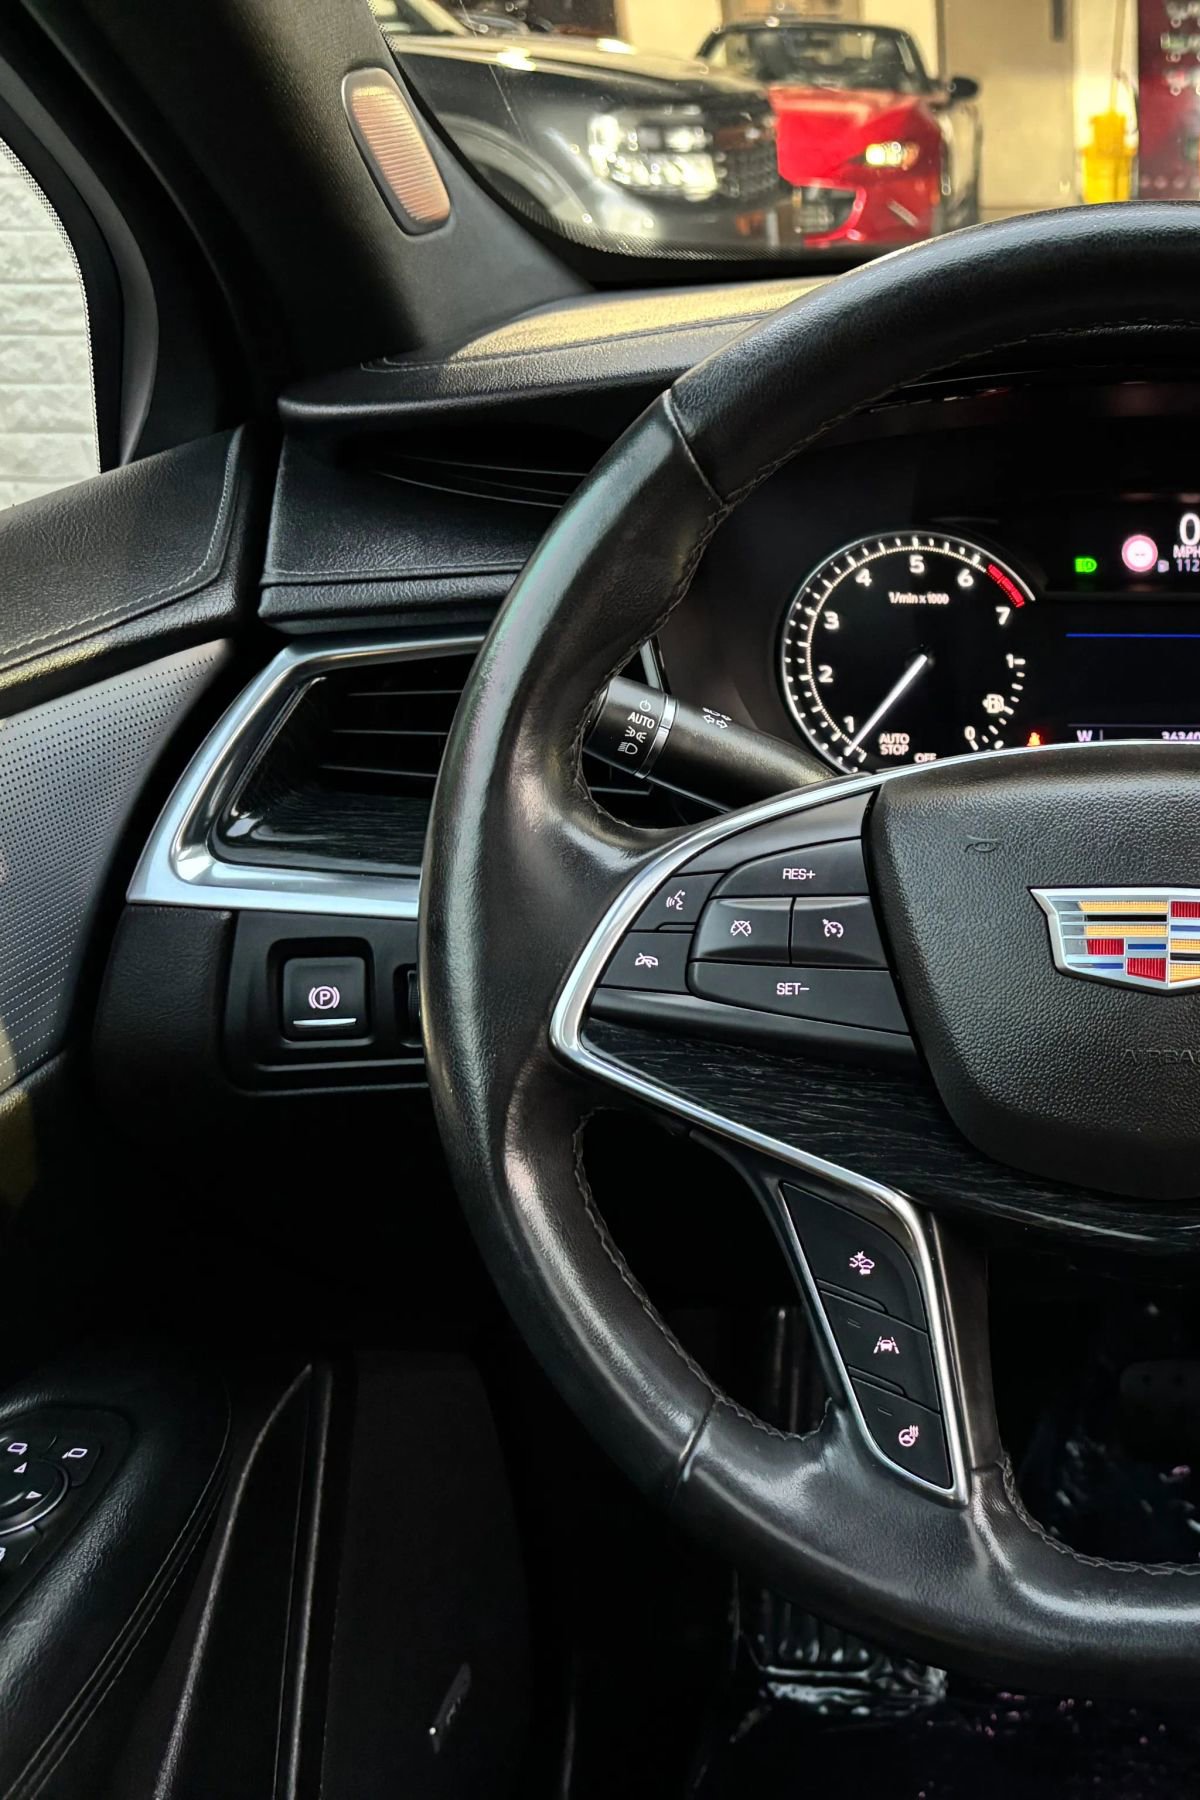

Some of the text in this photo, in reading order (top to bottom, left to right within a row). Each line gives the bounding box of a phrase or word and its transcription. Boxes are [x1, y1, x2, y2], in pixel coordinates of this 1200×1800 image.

[1179, 513, 1200, 546] 0
[909, 556, 925, 574] 5
[1176, 560, 1200, 572] 112
[855, 568, 872, 587] 4
[957, 569, 974, 588] 6
[824, 611, 840, 630] 3
[995, 606, 1012, 625] 7
[818, 664, 834, 683] 2
[627, 712, 655, 729] AUTO
[843, 715, 855, 733] 1
[879, 733, 910, 745] AUTO
[1077, 730, 1093, 742] W
[880, 744, 909, 756] STOP
[914, 752, 937, 763] OFF
[782, 867, 816, 881] RES+
